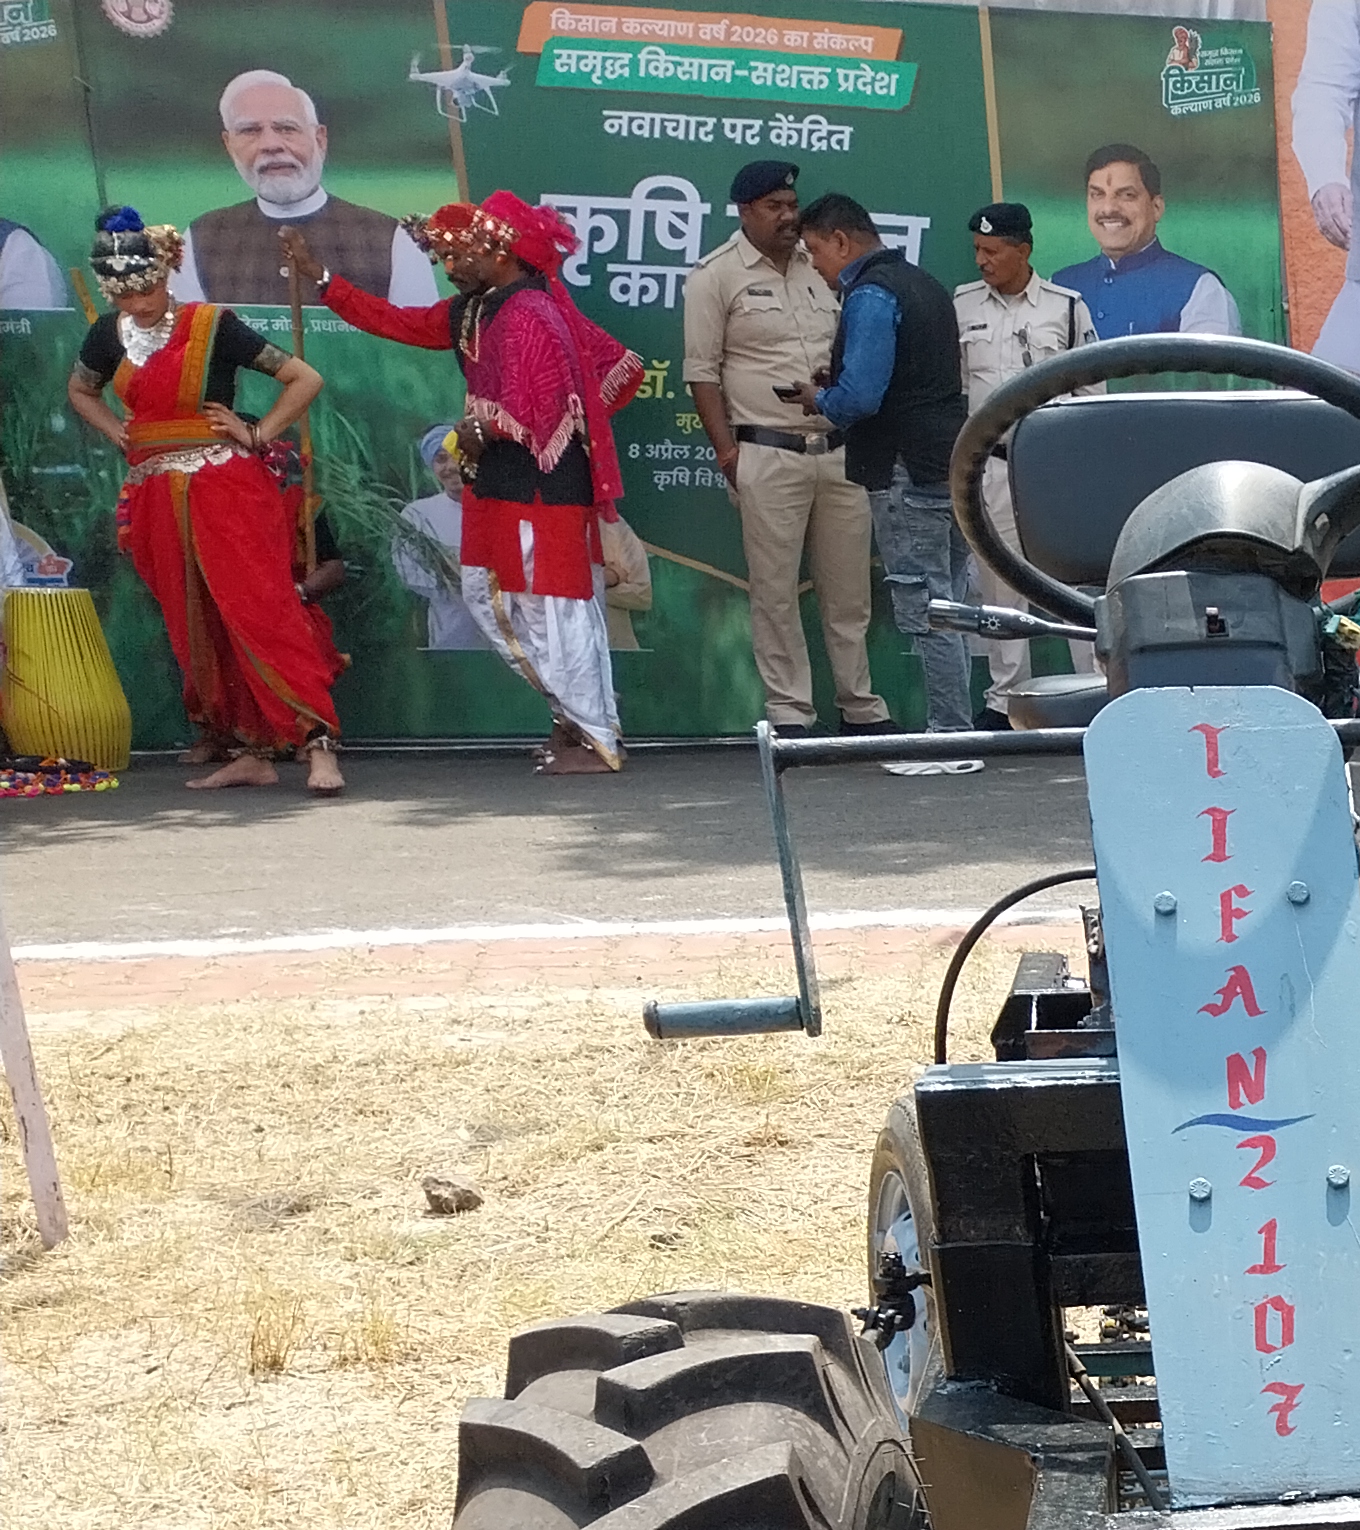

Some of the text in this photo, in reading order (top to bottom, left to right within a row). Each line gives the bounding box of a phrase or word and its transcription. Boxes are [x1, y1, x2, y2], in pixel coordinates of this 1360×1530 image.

[22, 25, 57, 42] 2026
[550, 9, 873, 52] किसान कल्याण वर्ष 2026 का संकल्प
[553, 46, 898, 96] समृद्ध किसान-सशक्त प्रदेश
[1170, 92, 1261, 115] कल्याण वर्ष 2026
[603, 110, 853, 152] नवाचार पर केंद्रित
[540, 175, 711, 287] कृषि
[628, 438, 718, 461] 8 अप्रैल 20
[653, 466, 691, 492] कृषि
[1188, 722, 1268, 1111] TIFAN
[1236, 1134, 1306, 1438] 2107
